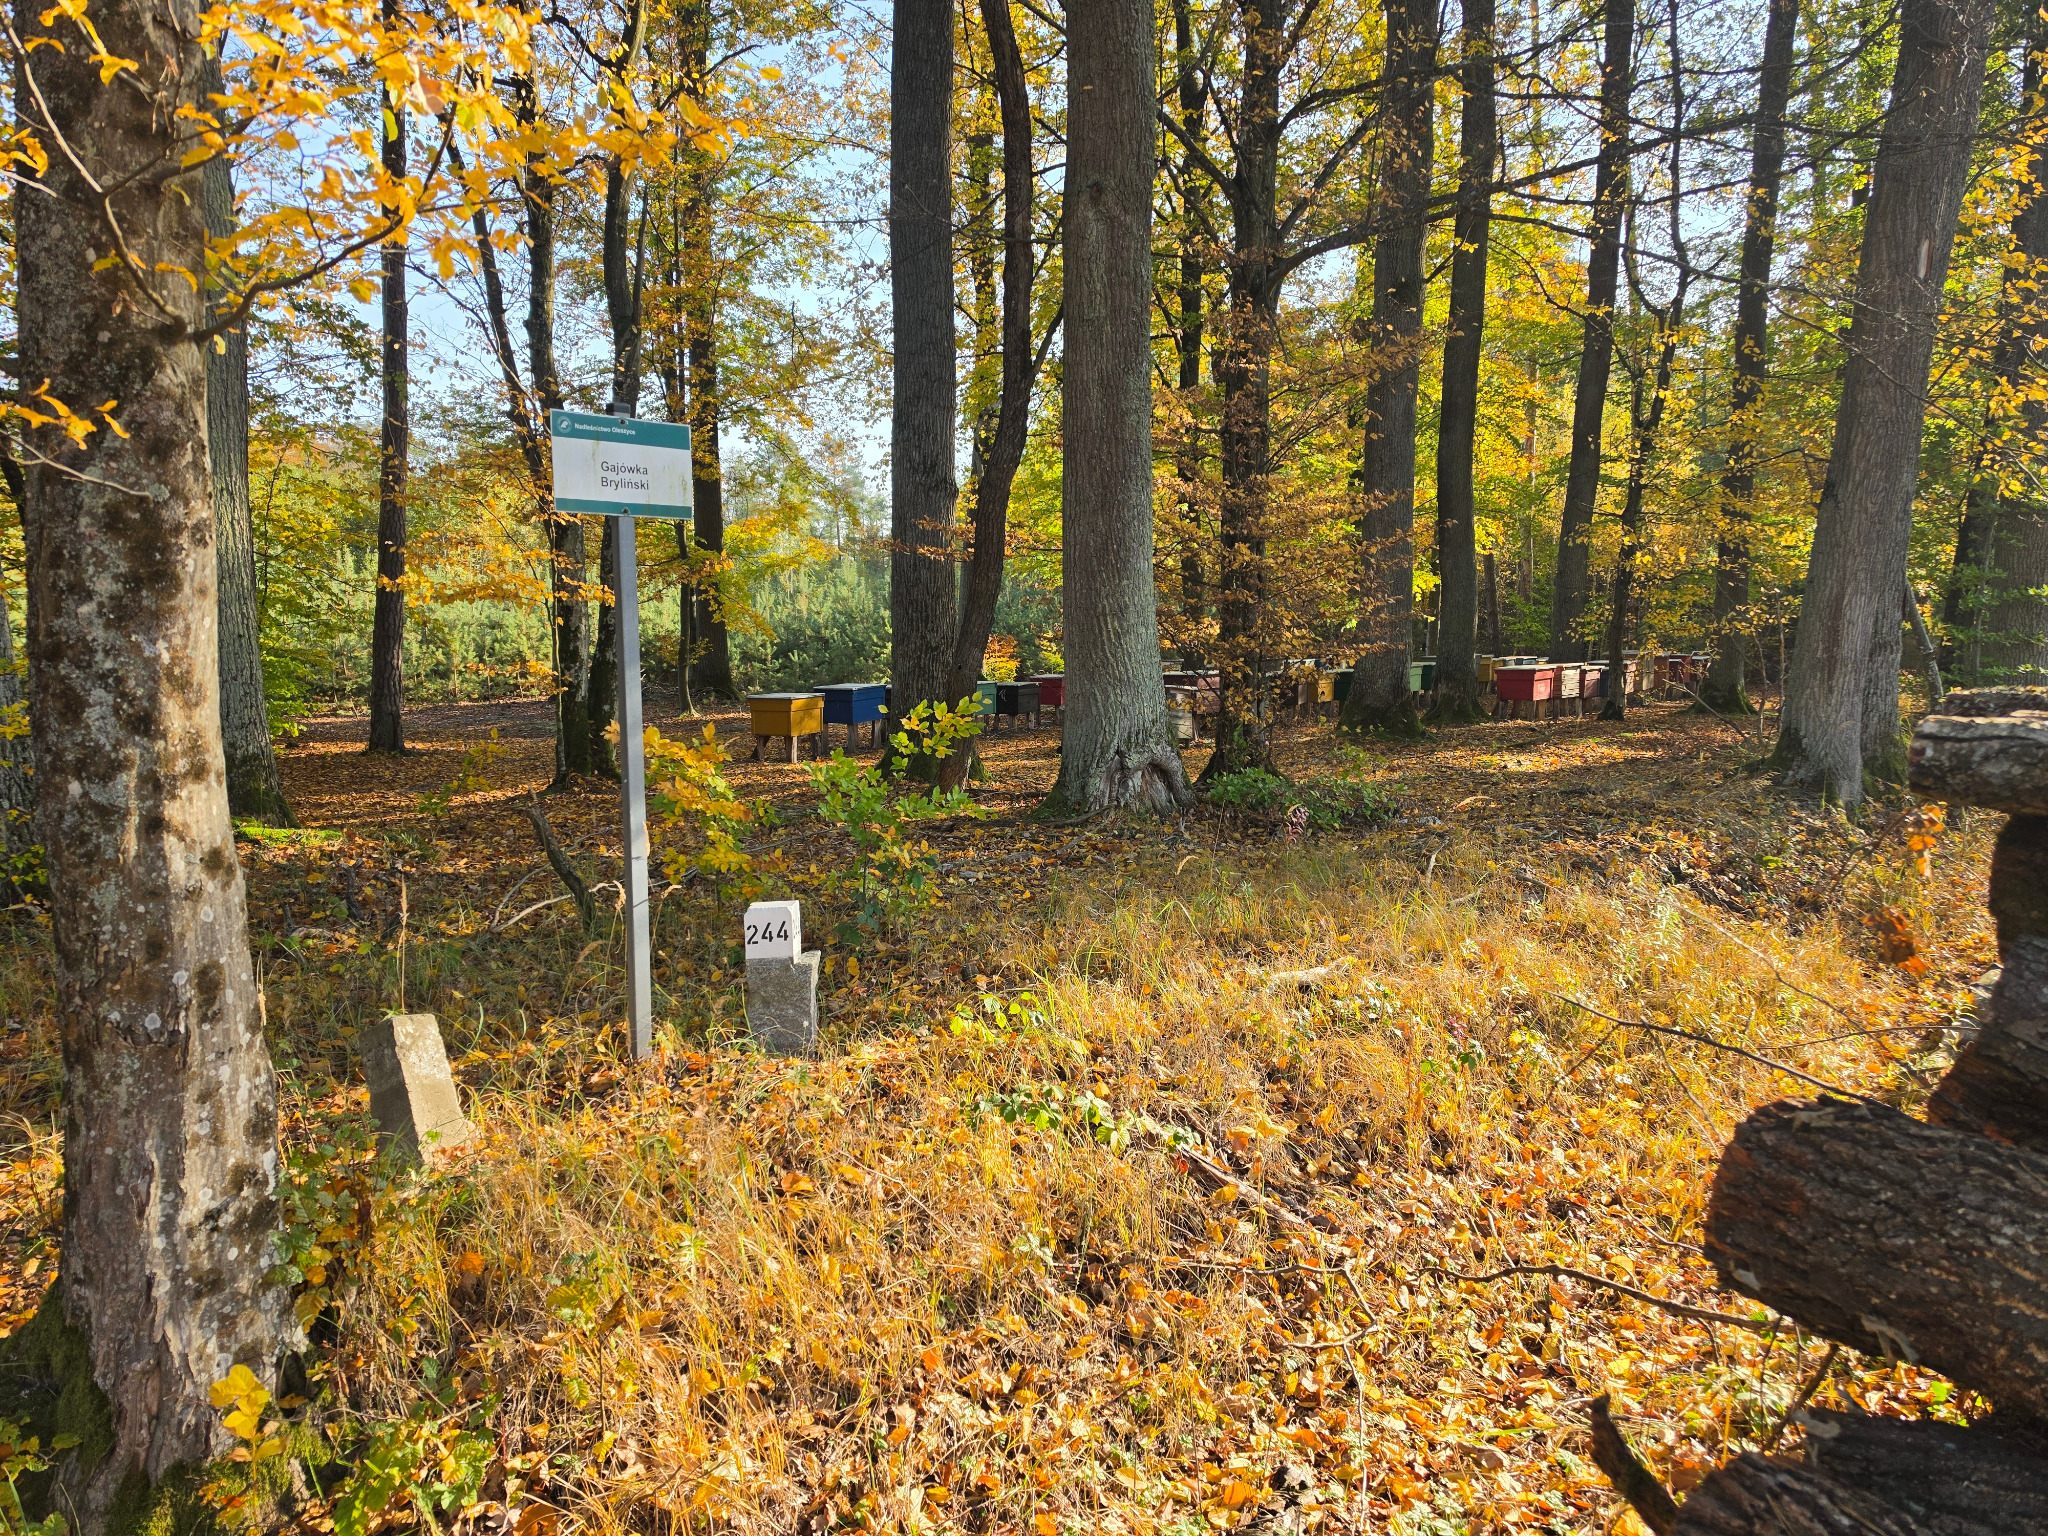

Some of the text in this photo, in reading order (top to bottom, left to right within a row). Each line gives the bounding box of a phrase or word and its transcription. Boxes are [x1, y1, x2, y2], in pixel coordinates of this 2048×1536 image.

[574, 422, 611, 433] Nadleśnictwo
[611, 427, 636, 435] Oleszyce
[600, 460, 648, 475] Gajówka
[601, 476, 649, 490] Bryliński
[746, 920, 789, 945] 244
